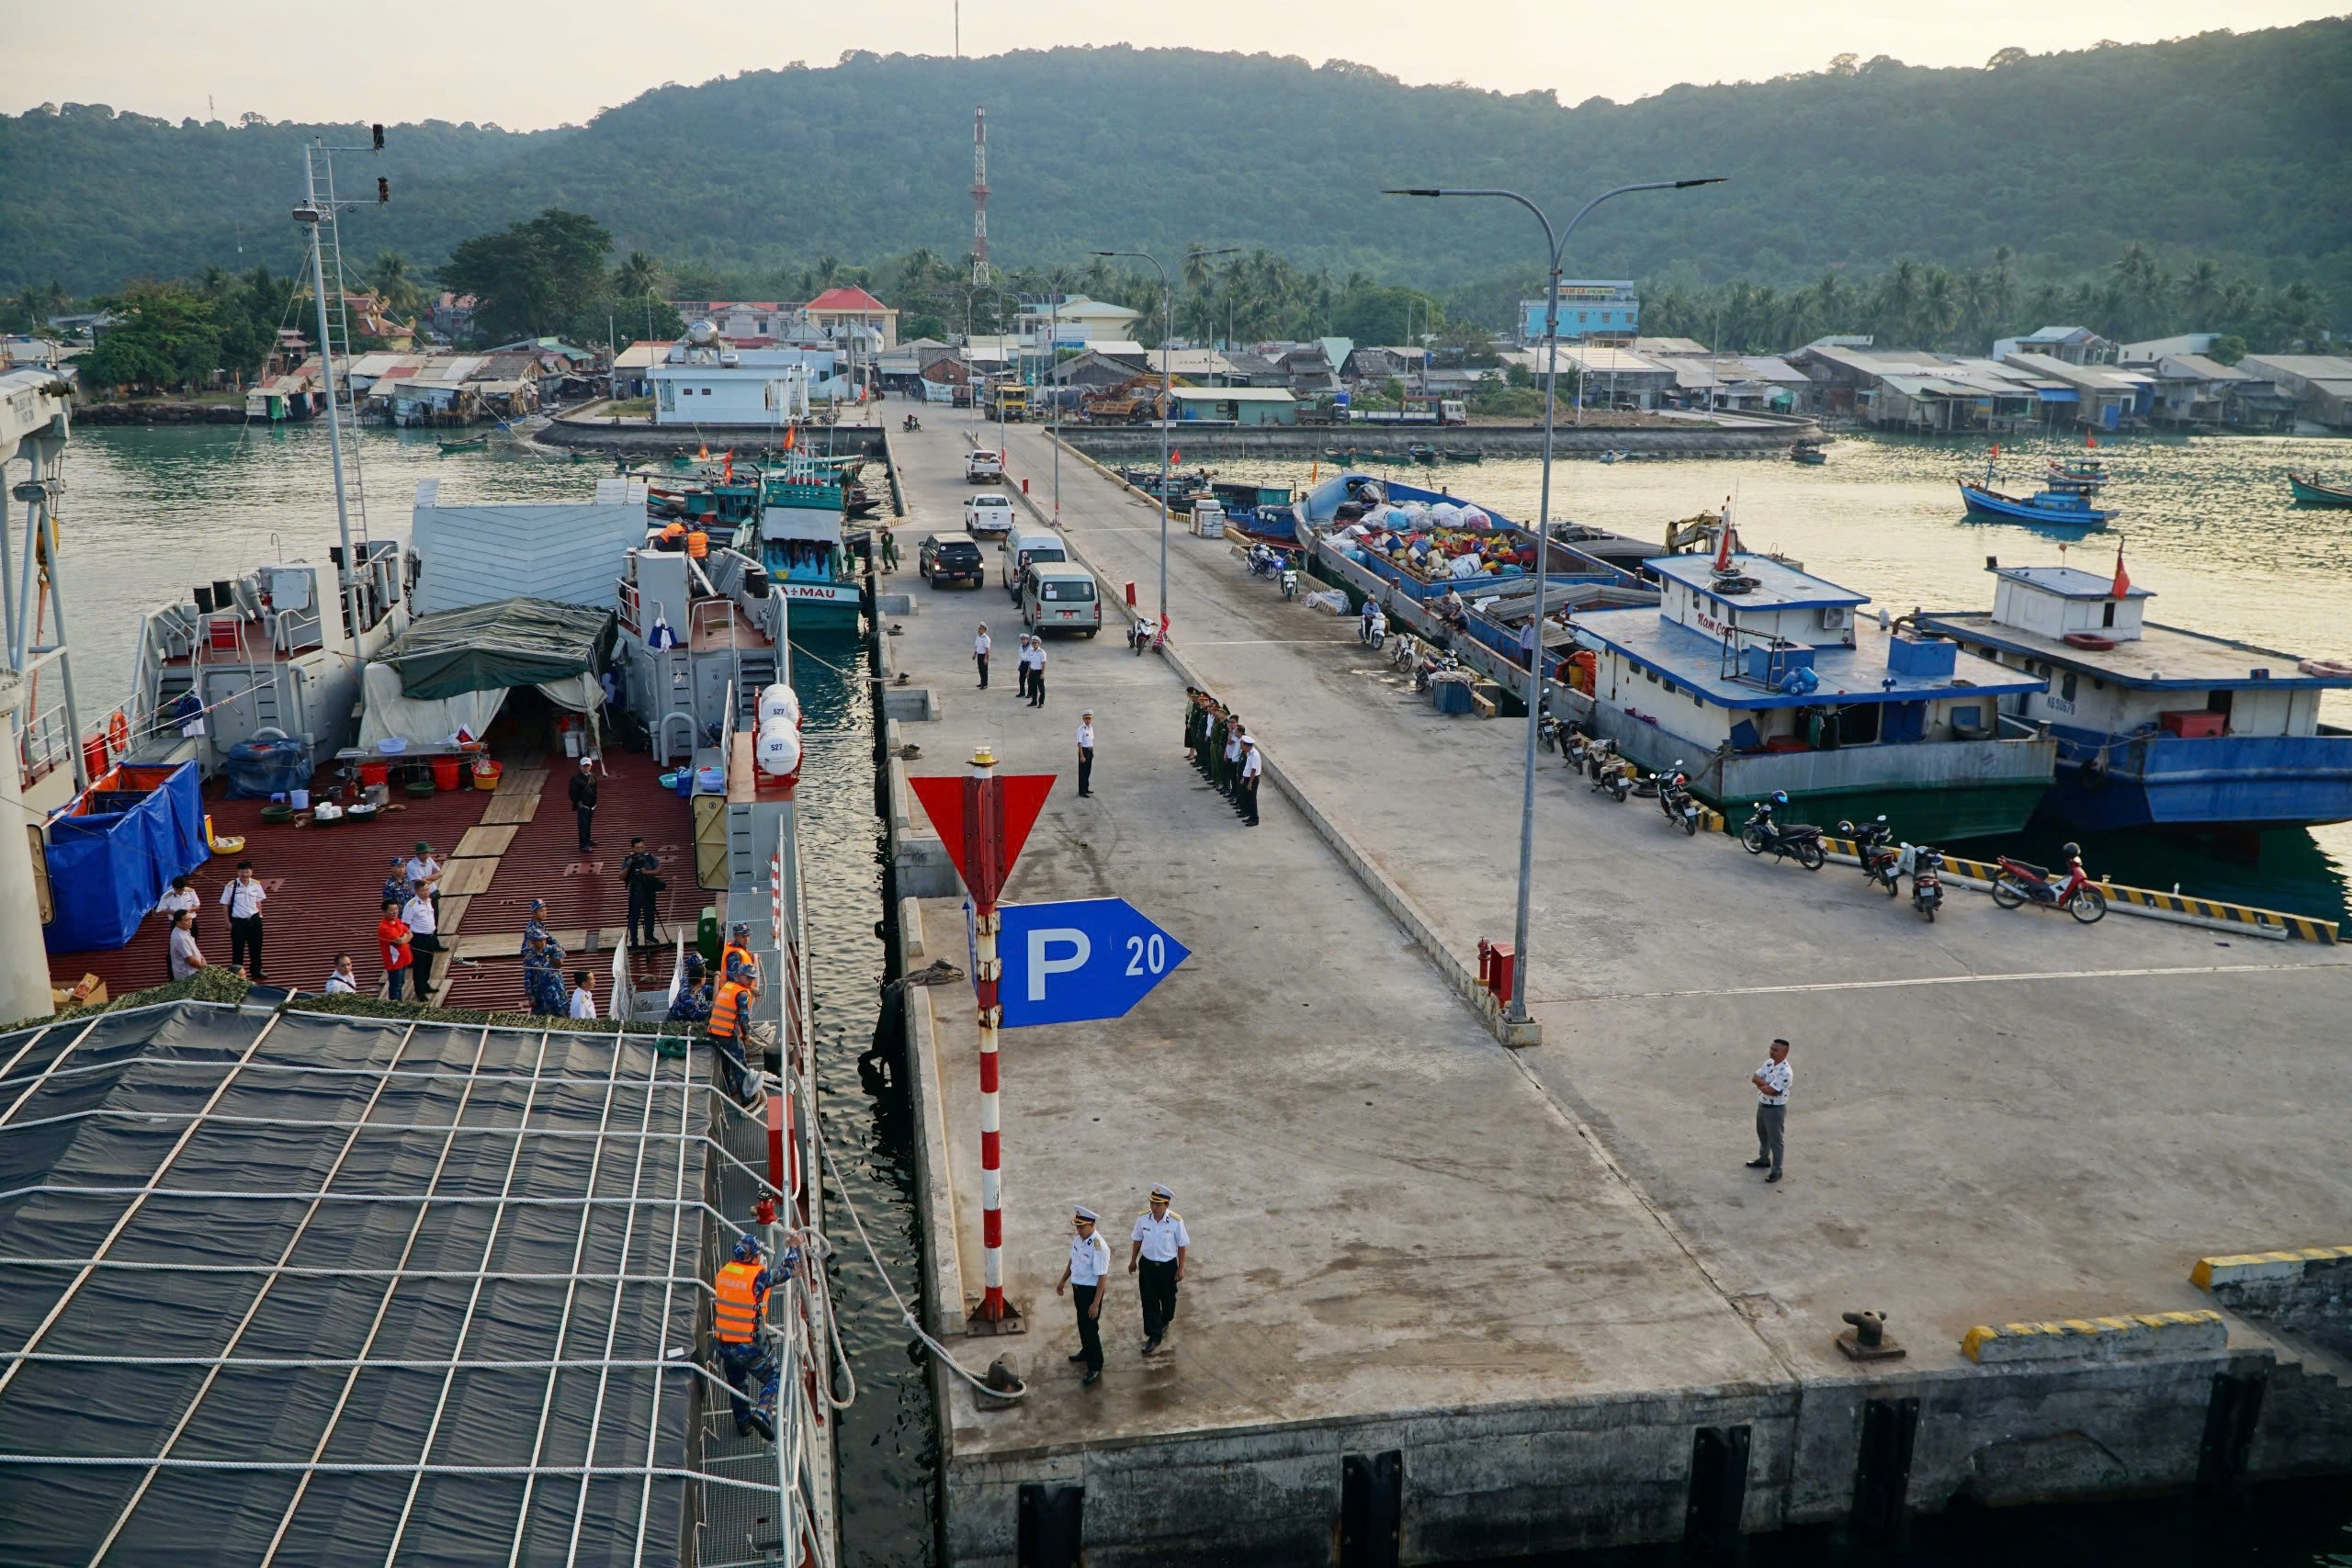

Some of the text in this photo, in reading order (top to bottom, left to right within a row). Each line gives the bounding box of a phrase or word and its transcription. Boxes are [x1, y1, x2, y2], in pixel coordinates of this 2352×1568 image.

[799, 587, 835, 598] MAU
[1698, 613, 1715, 631] Nam
[1027, 928, 1091, 1001] P
[1125, 933, 1165, 976] 20
